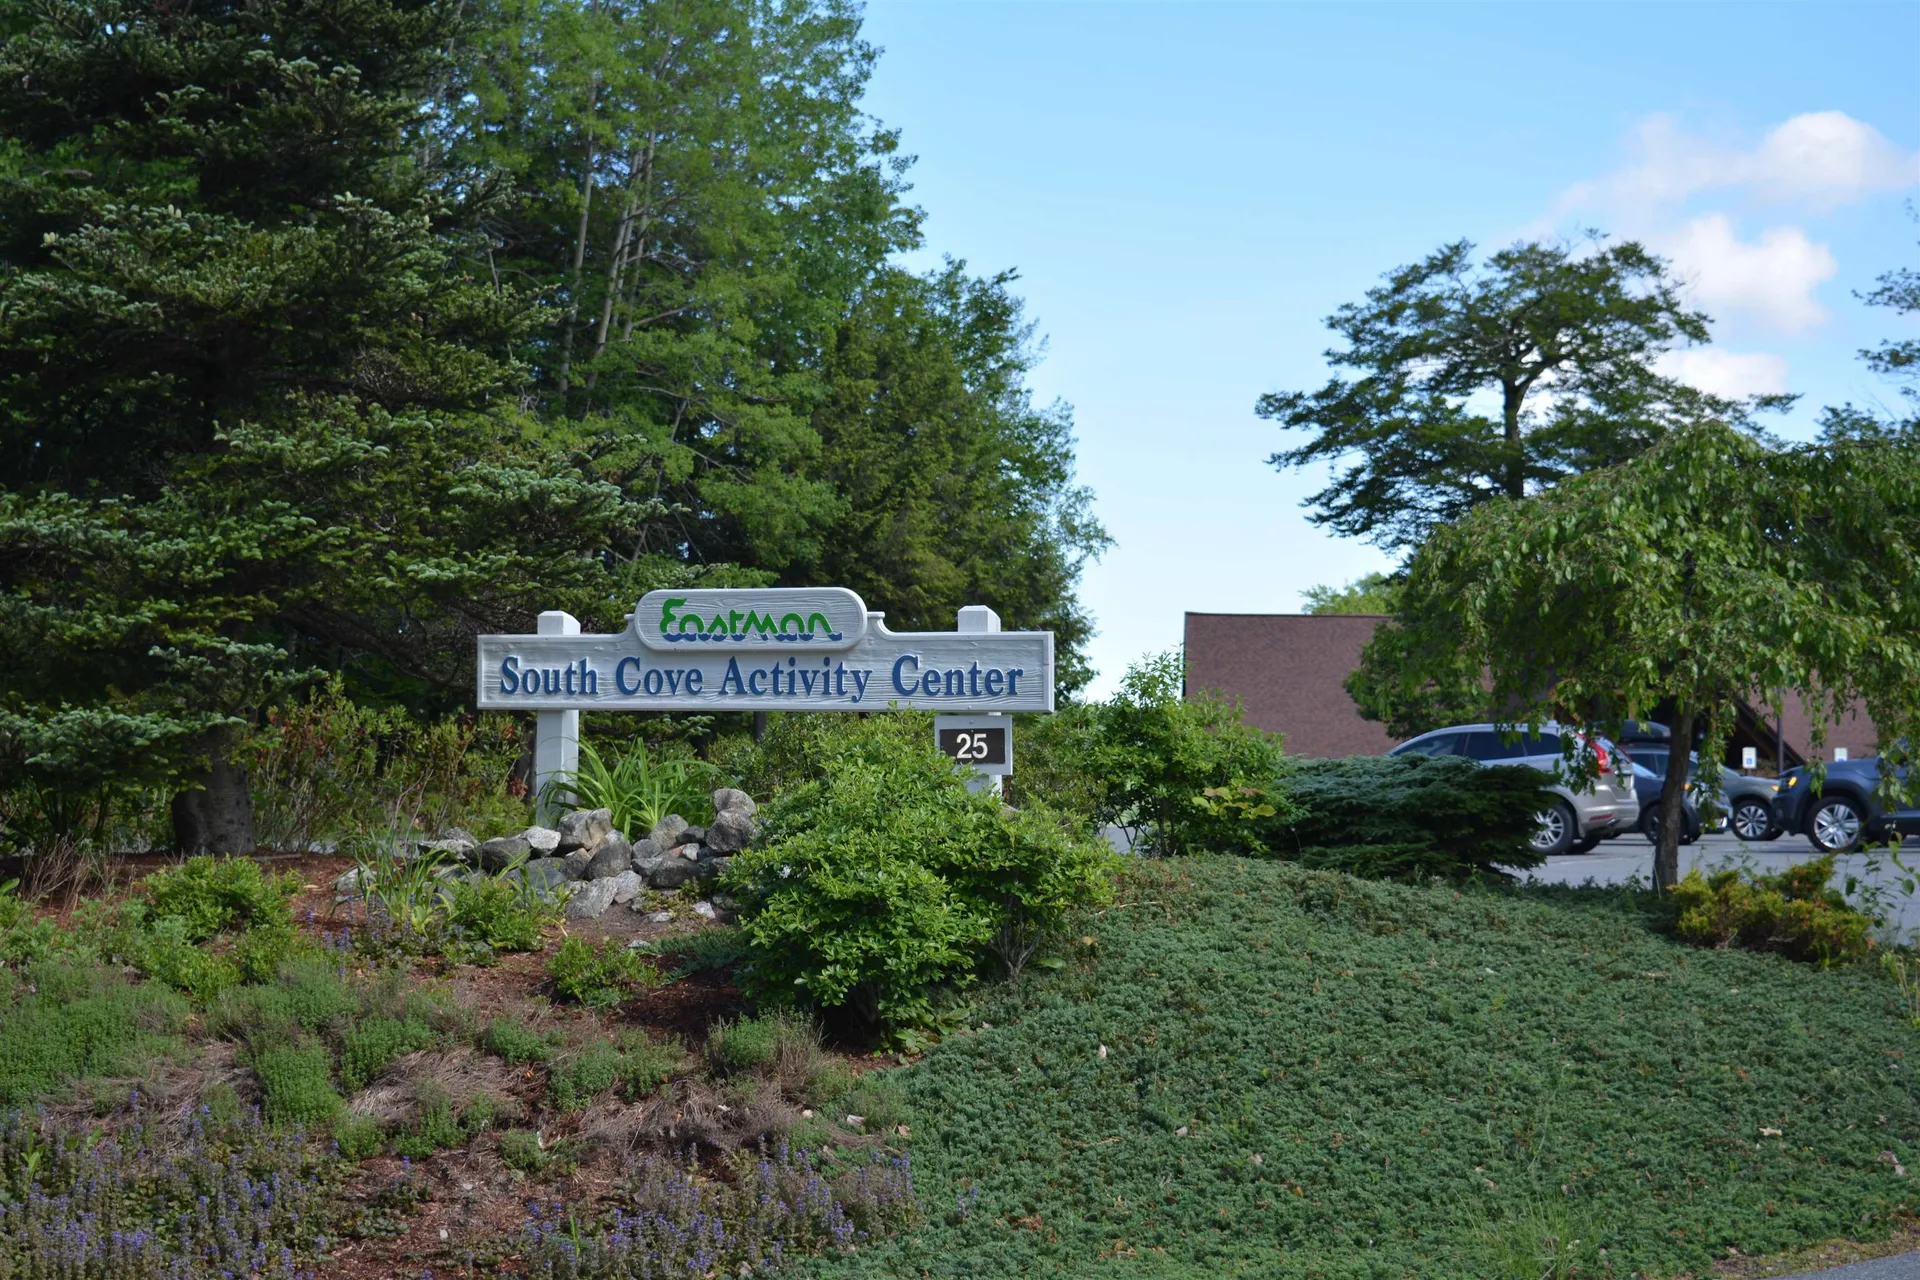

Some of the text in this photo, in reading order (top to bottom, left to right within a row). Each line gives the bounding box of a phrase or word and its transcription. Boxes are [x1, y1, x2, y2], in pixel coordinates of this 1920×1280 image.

[659, 598, 836, 637] Eastman
[500, 654, 1024, 702] South Cove Activity Center
[956, 733, 988, 760] 25
